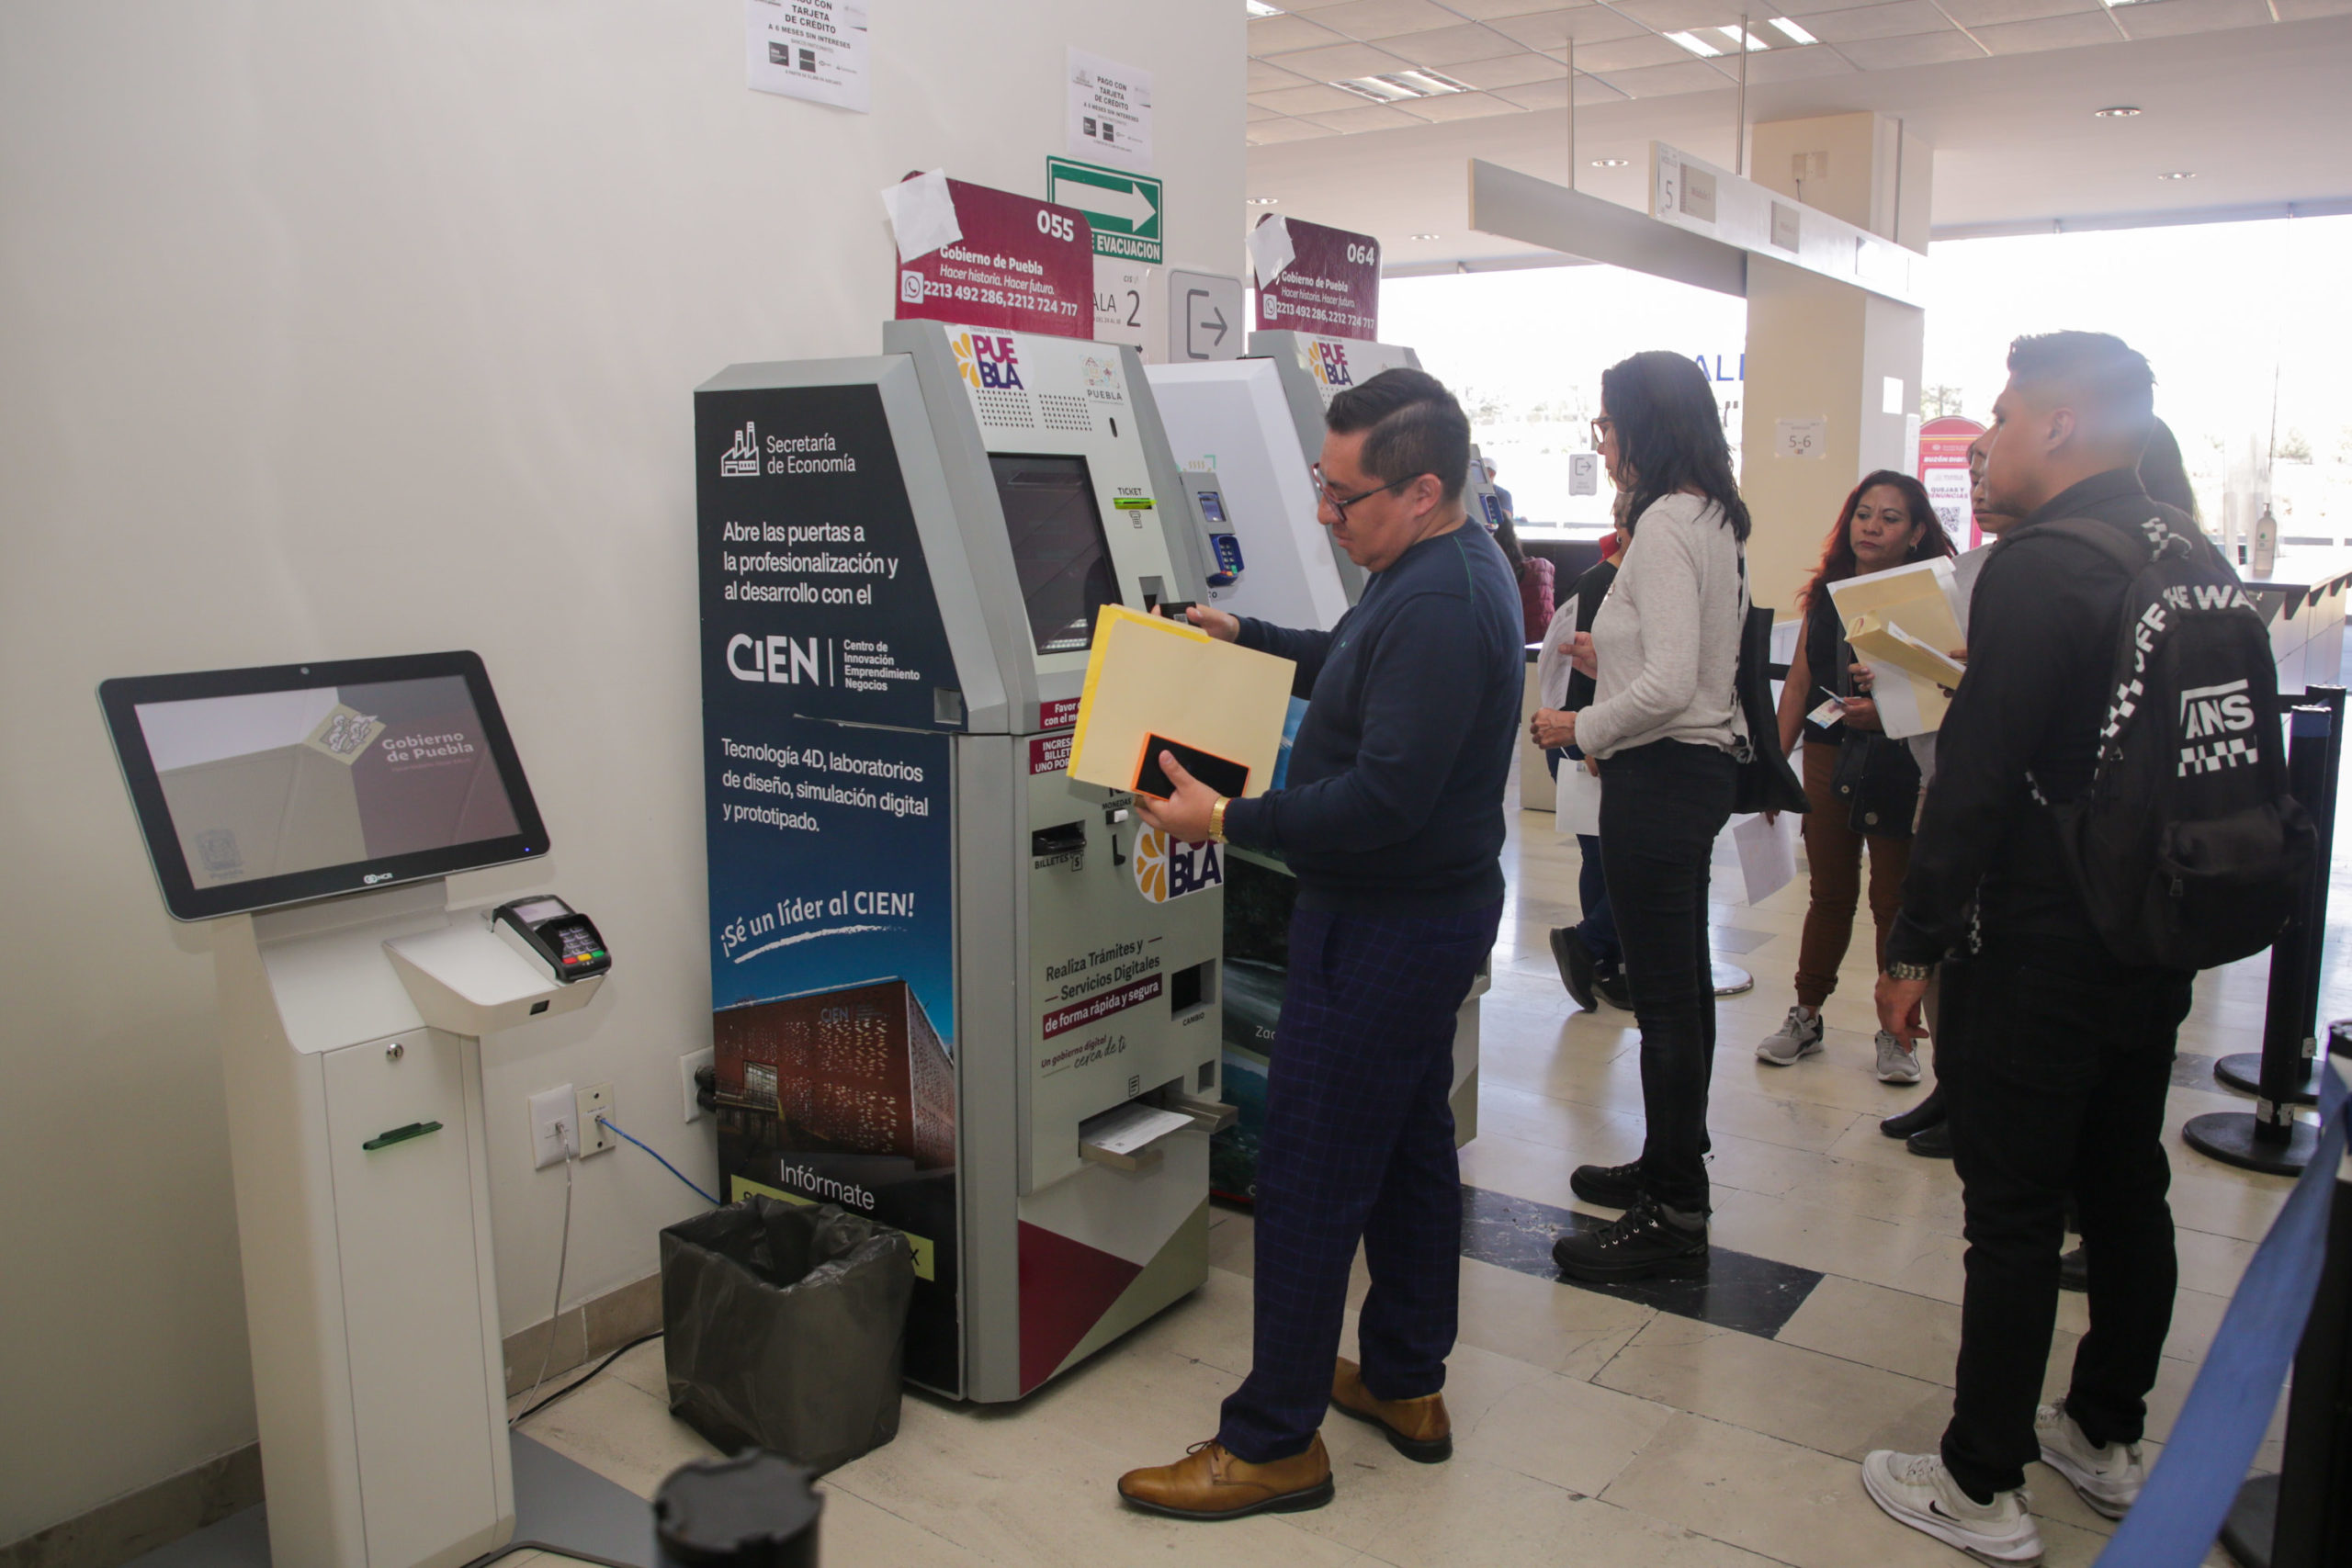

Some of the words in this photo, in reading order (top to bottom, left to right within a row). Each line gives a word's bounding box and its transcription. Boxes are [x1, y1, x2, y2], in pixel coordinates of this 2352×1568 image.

[785, 14, 797, 24] DE
[792, 5, 830, 21] TARJETA
[781, 26, 805, 37] MESES
[818, 34, 851, 50] INTERESES
[1097, 75, 1114, 87] PAGO
[1114, 81, 1127, 91] CON
[1100, 86, 1125, 100] TARJETA
[1094, 94, 1102, 103] DE
[1036, 209, 1075, 242] 055
[940, 245, 991, 266] Gobierno
[993, 254, 1007, 268] de
[1009, 257, 1044, 276] Puebla
[1347, 243, 1375, 266] 064
[940, 264, 967, 281] Hacer
[968, 268, 1002, 287] historia.
[1003, 275, 1029, 291] Hacer
[1029, 279, 1055, 296] futuro.
[1282, 271, 1314, 287] Gobierno
[1316, 276, 1324, 288] de
[1326, 278, 1349, 293] Puebla
[924, 280, 953, 299] 2213
[955, 285, 978, 302] 492
[1037, 298, 1058, 313] 724
[1060, 301, 1078, 317] 717
[1093, 292, 1116, 313] ALA
[1126, 289, 1141, 328] 2
[1277, 301, 1295, 316] 2213
[1296, 304, 1311, 319] 492
[1348, 313, 1363, 327] 724
[1363, 316, 1375, 330] 717
[971, 333, 1019, 365] PUE
[1318, 342, 1348, 366] PUE
[978, 361, 1024, 390] BLA
[1325, 363, 1353, 386] BLA
[1087, 389, 1124, 401] PUEBLA
[766, 434, 836, 453] Secretaría
[1788, 434, 1812, 448] 5-6
[767, 457, 785, 474] de
[788, 454, 856, 474] Economía
[1117, 488, 1141, 496] TICKET
[723, 522, 760, 542] Abre
[763, 522, 785, 542] las
[788, 523, 851, 547] puertas
[854, 526, 865, 542] a
[724, 551, 737, 571] la
[741, 552, 884, 575] profesionalización
[888, 558, 899, 579] y
[725, 581, 737, 601] al
[741, 581, 819, 604] desarrollo
[822, 589, 853, 604] con
[856, 584, 872, 604] el
[2193, 585, 2257, 612] WA
[843, 639, 874, 651] Centro
[876, 641, 888, 653] de
[727, 633, 820, 686] CIEN
[844, 652, 894, 666] Innovación
[844, 665, 920, 681] Emprendimiento
[845, 677, 888, 692] Negocios
[1045, 716, 1058, 727] con
[1060, 713, 1068, 723] el
[1055, 703, 1076, 714] Favor
[382, 733, 464, 750] Gobierno
[387, 750, 410, 762] de
[413, 743, 474, 760] Puebla
[721, 738, 799, 768] Tecnología
[802, 749, 827, 773] 4D,
[830, 751, 923, 782] laboratorios
[1045, 748, 1071, 761] BILLET
[1035, 761, 1053, 773] UNO
[722, 770, 741, 787] de
[743, 773, 794, 799] diseño,
[797, 781, 876, 808] simulación
[880, 792, 929, 818] digital
[1102, 797, 1131, 809] MONEDAS
[723, 802, 731, 820] y
[735, 805, 820, 831] prototipado.
[1035, 852, 1069, 869] BILLETES
[1169, 842, 1222, 898] BLA
[720, 917, 747, 958] ¡Sé
[750, 912, 775, 937] un
[777, 897, 824, 927] líder
[829, 890, 848, 917] al
[854, 891, 915, 917] CIEN!
[1046, 958, 1086, 982] Realiza
[1088, 942, 1136, 967] Trámites
[1136, 940, 1144, 954] y
[1061, 972, 1112, 1000] Servicios
[1114, 955, 1160, 981] Digitales
[1046, 1018, 1058, 1032] de
[1058, 1008, 1089, 1027] forma
[1090, 995, 1121, 1015] rápida
[1122, 993, 1128, 1007] y
[1128, 981, 1159, 1001] segura
[1182, 1011, 1205, 1027] CAMBIO
[1256, 1025, 1276, 1040] Zac
[1041, 1058, 1051, 1068] Un
[1052, 1045, 1083, 1066] gobierno
[1084, 1034, 1107, 1052] digital
[1074, 1052, 1102, 1069] cerca
[1104, 1036, 1116, 1056] de
[780, 1157, 875, 1211] Infórmate
